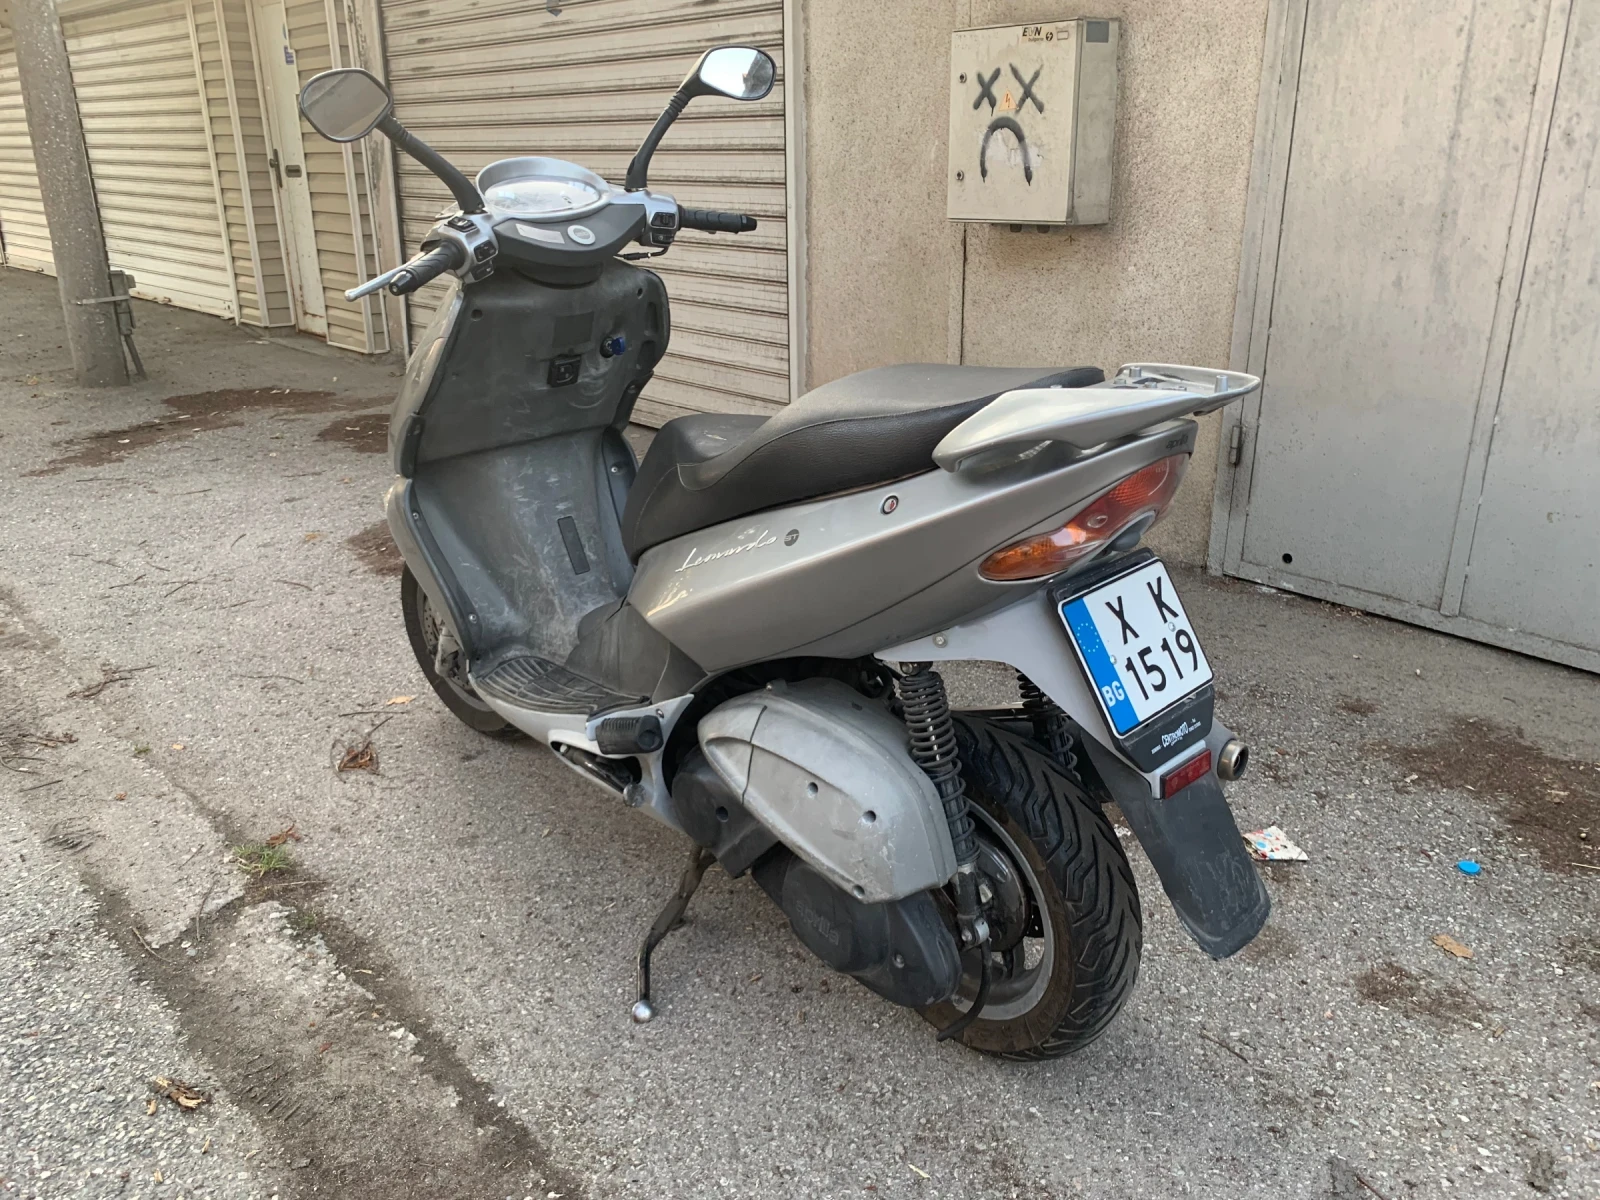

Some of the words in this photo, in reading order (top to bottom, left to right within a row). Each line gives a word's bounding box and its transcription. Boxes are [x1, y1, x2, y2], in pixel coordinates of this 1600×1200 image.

[1022, 26, 1042, 37] EVN
[675, 530, 777, 572] Leonardo
[1105, 595, 1140, 645] X
[1146, 576, 1179, 624] K
[1125, 629, 1198, 701] 1519
[1102, 681, 1125, 707] BG
